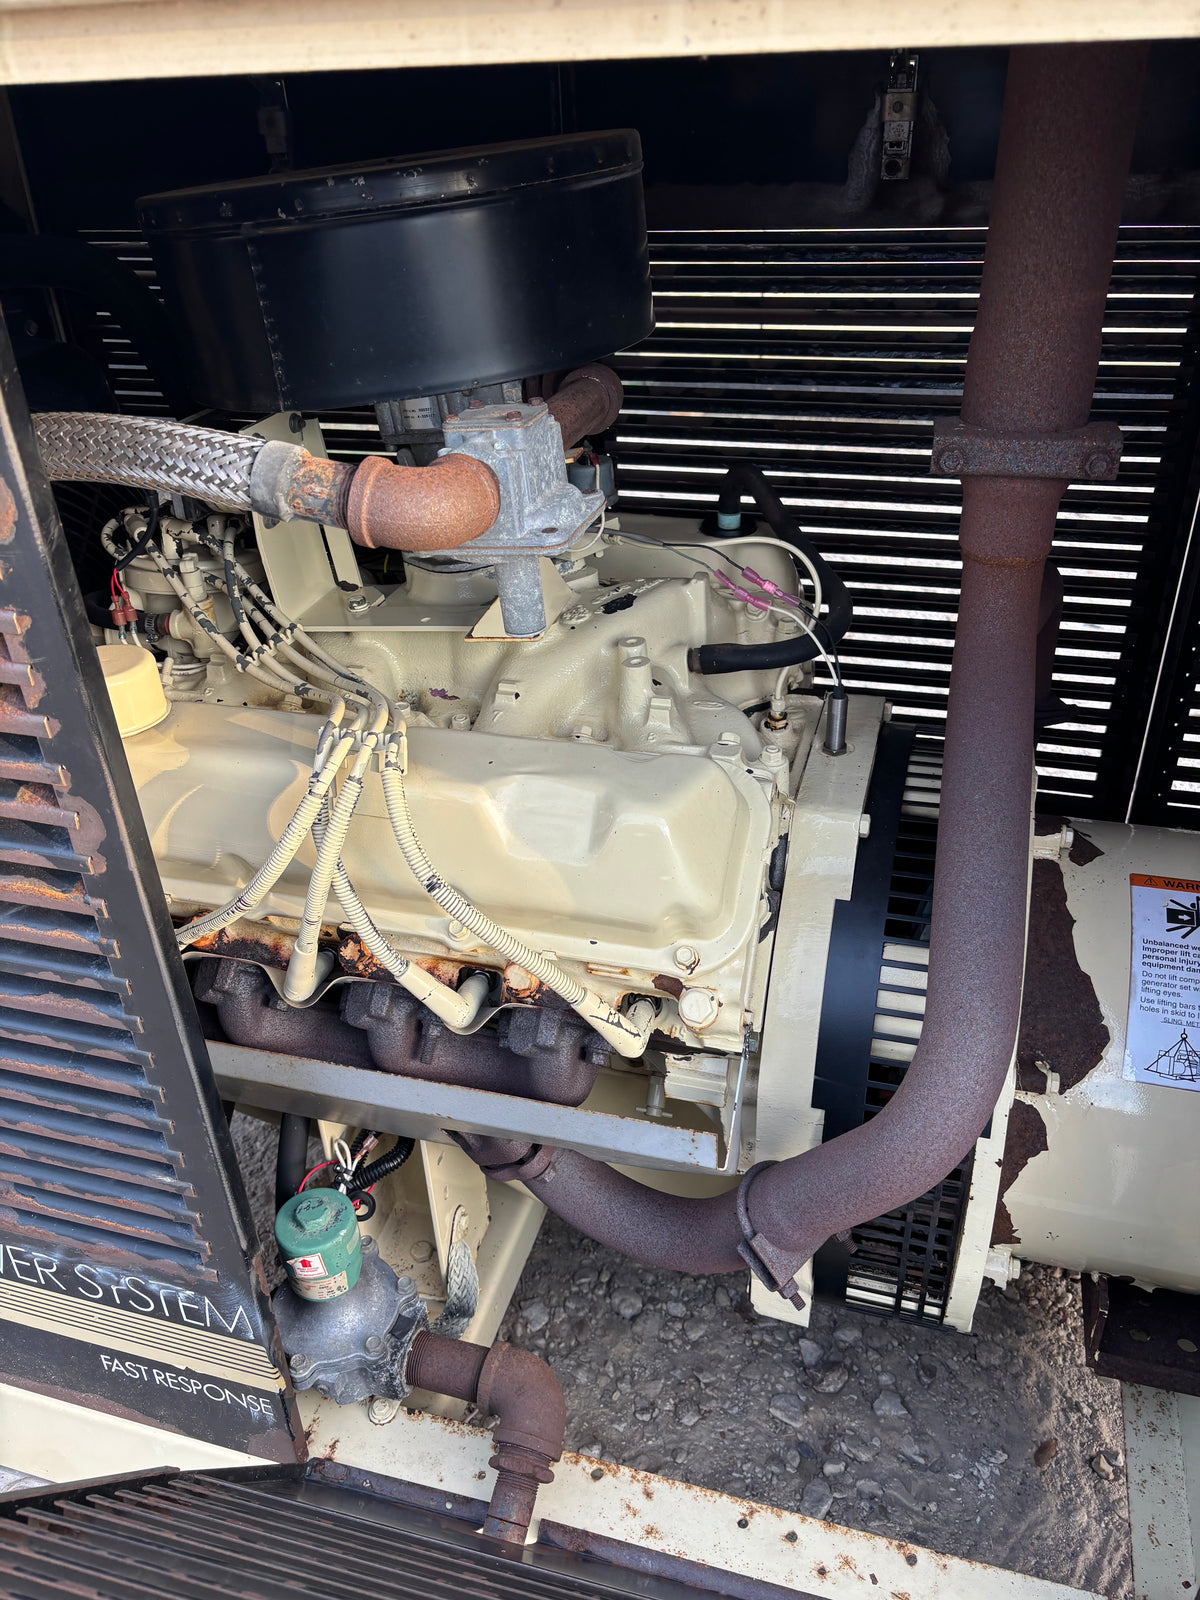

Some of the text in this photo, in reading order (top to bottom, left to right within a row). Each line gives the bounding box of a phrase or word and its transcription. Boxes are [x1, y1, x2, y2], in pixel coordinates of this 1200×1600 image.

[1142, 938, 1189, 950] Unbalanced
[1142, 946, 1178, 956] Improper
[1142, 953, 1177, 963] personal
[1142, 961, 1184, 972] equipment
[1142, 970, 1153, 978] Do
[1141, 986, 1161, 996] lifting
[1142, 979, 1178, 989] generator
[1180, 984, 1191, 992] set
[1140, 996, 1155, 1004] Use
[1157, 998, 1177, 1009] lifting
[1179, 1002, 1196, 1011] bars
[1139, 1004, 1160, 1013] holes
[1162, 1007, 1169, 1015] in
[1170, 1009, 1186, 1018] skid
[1188, 1011, 1196, 1019] to
[1163, 1017, 1183, 1026] SLING
[74, 1262, 255, 1340] SYSTEM
[100, 1354, 275, 1416] FAST RESPONSE
